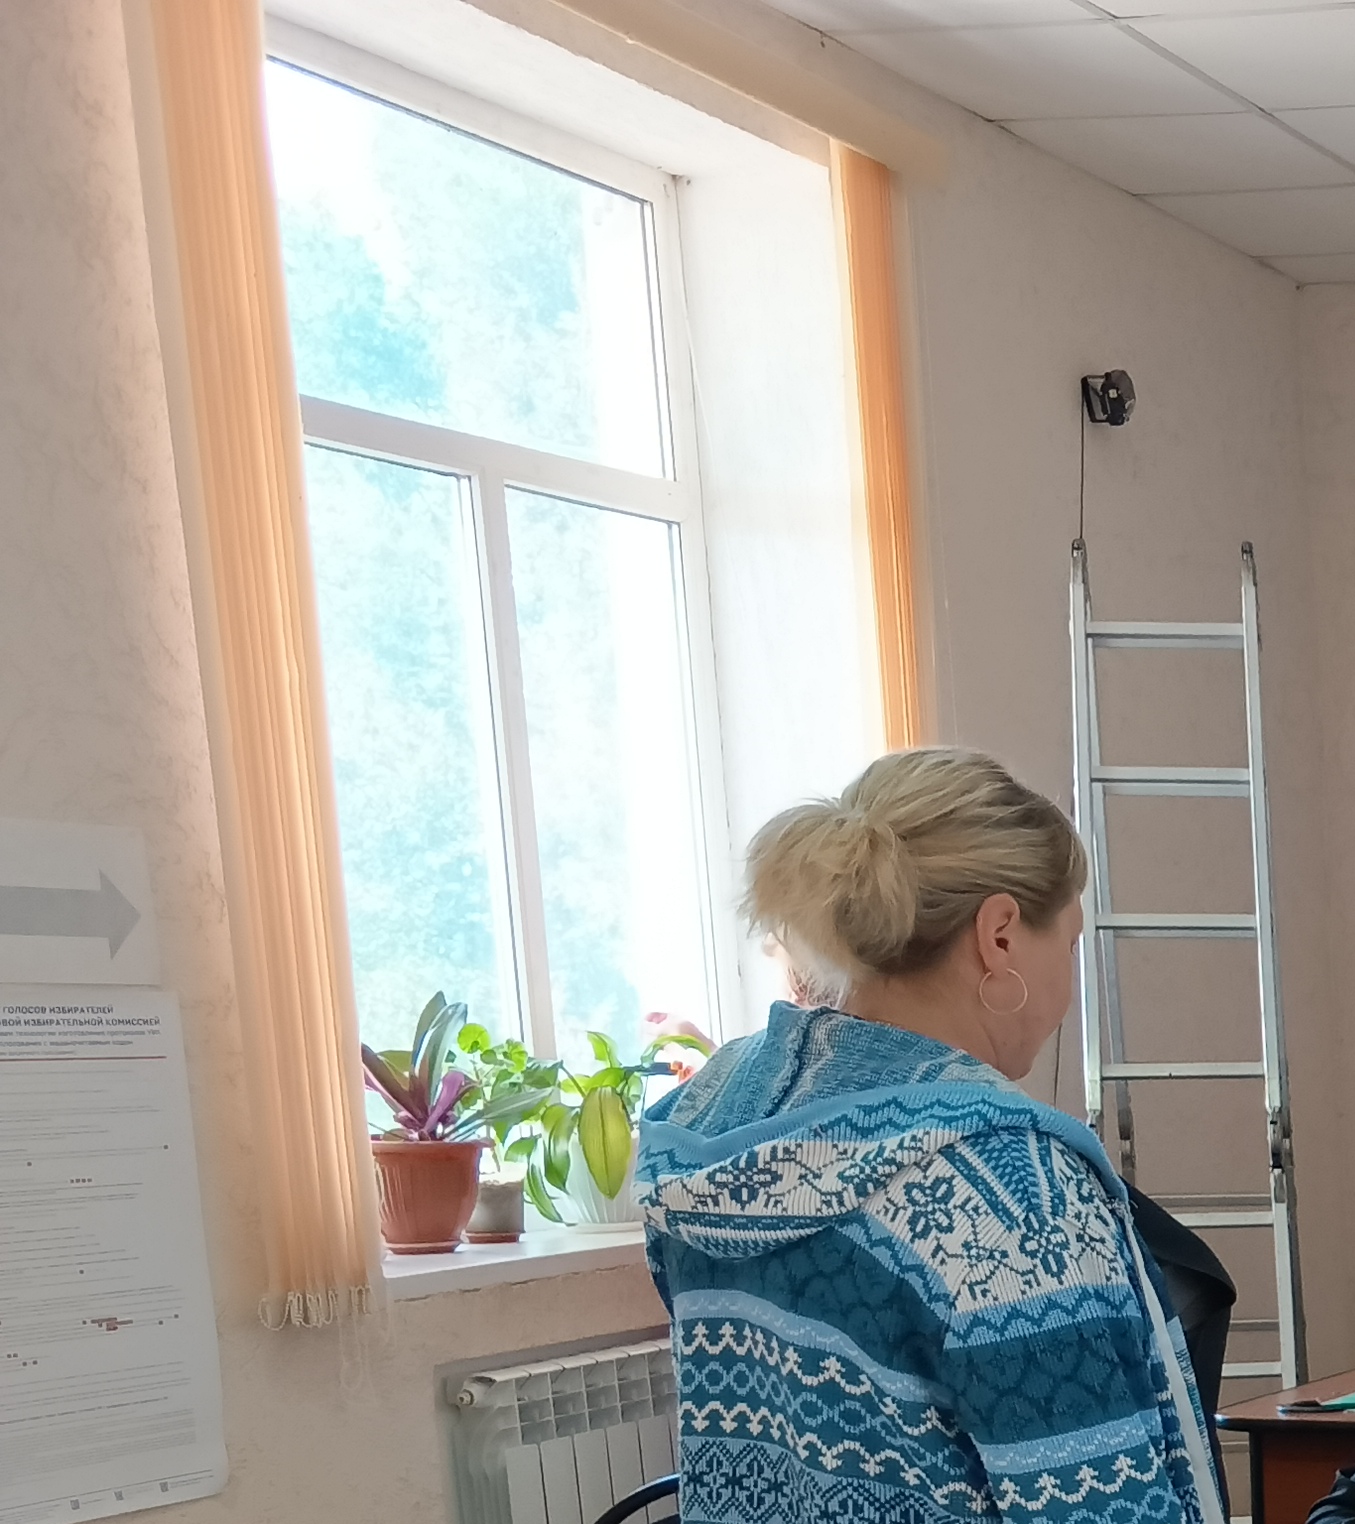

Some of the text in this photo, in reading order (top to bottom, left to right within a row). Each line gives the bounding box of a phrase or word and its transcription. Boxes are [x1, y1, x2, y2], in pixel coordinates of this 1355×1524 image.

[3, 1005, 114, 1014] ГОЛОСОВ ИЗБИРАТЕЛЕЙ
[0, 1015, 161, 1026] ВОЙ ИЗБИРАТЕЛЬНОЙ КОМИССИЕЙ
